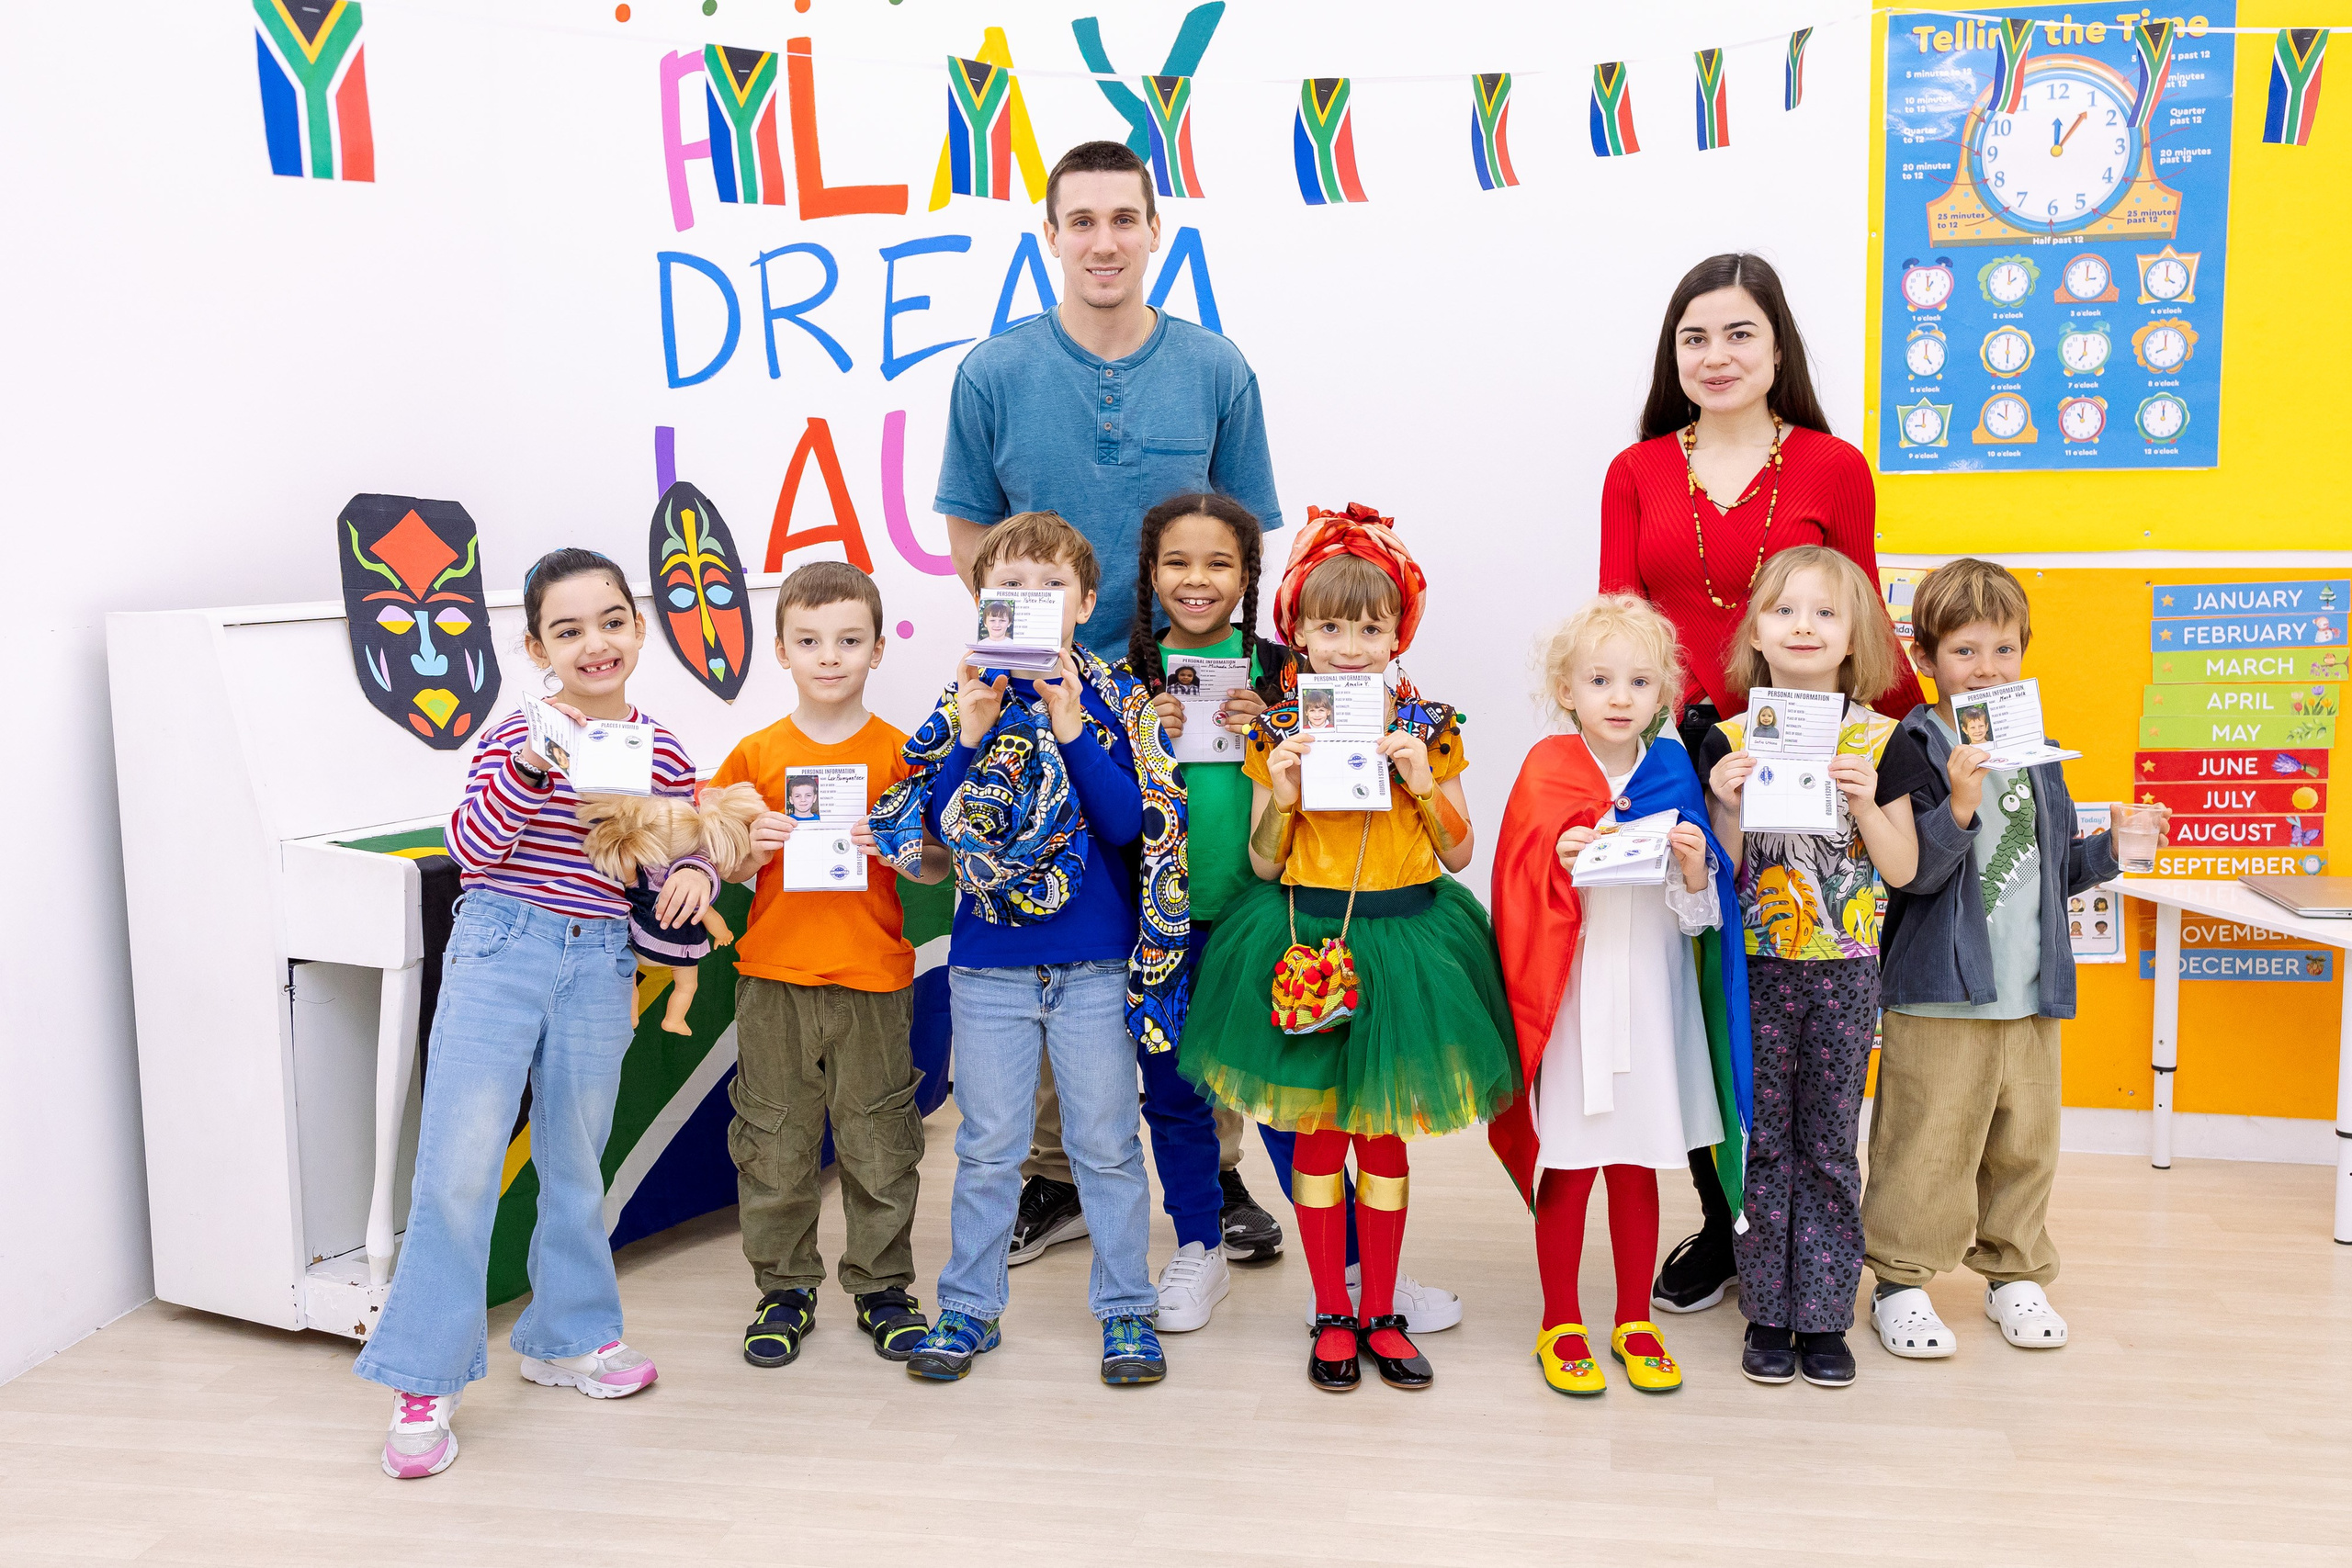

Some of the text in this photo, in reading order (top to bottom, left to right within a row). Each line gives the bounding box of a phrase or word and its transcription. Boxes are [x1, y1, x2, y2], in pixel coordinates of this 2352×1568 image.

[1912, 19, 2032, 53] Tellin
[2044, 14, 2107, 45] the
[2178, 51, 2198, 61] past
[2201, 50, 2211, 59] 12
[1914, 69, 1949, 78] minutes
[1917, 96, 1952, 104] minutes
[2047, 84, 2069, 100] 12
[2087, 91, 2097, 107] 1
[2017, 95, 2029, 111] 1
[2106, 110, 2117, 126] 2
[2170, 108, 2206, 118] Quarter
[2170, 116, 2202, 126] past 12
[1903, 127, 1938, 136] Quarter
[1991, 119, 2012, 136] 10
[1987, 146, 1998, 163] 9
[2115, 138, 2126, 155] 3
[2175, 147, 2211, 156] minutes
[1916, 162, 1951, 170] minutes
[2160, 156, 2180, 165] past
[1994, 171, 2005, 187] 8
[2102, 167, 2113, 183] 4
[2017, 192, 2028, 208] 7
[2047, 199, 2058, 216] 6
[2075, 193, 2086, 210] 5
[2033, 237, 2051, 245] Half
[2053, 237, 2071, 246] past
[2194, 589, 2303, 611] JANUARY
[2184, 622, 2307, 645] FEBRUARY
[2206, 658, 2294, 676] MARCH
[1968, 685, 2024, 701] PERSONAL INFORMATION
[2207, 692, 2274, 711] APRIL
[2211, 724, 2262, 742] MAY
[2198, 758, 2258, 776] JUNE
[2203, 790, 2256, 809] JULY
[2081, 816, 2106, 825] Today?
[2177, 824, 2276, 841] AUGUST
[2159, 857, 2296, 875] SEPTEMBER
[2182, 925, 2297, 943] OVEMBE
